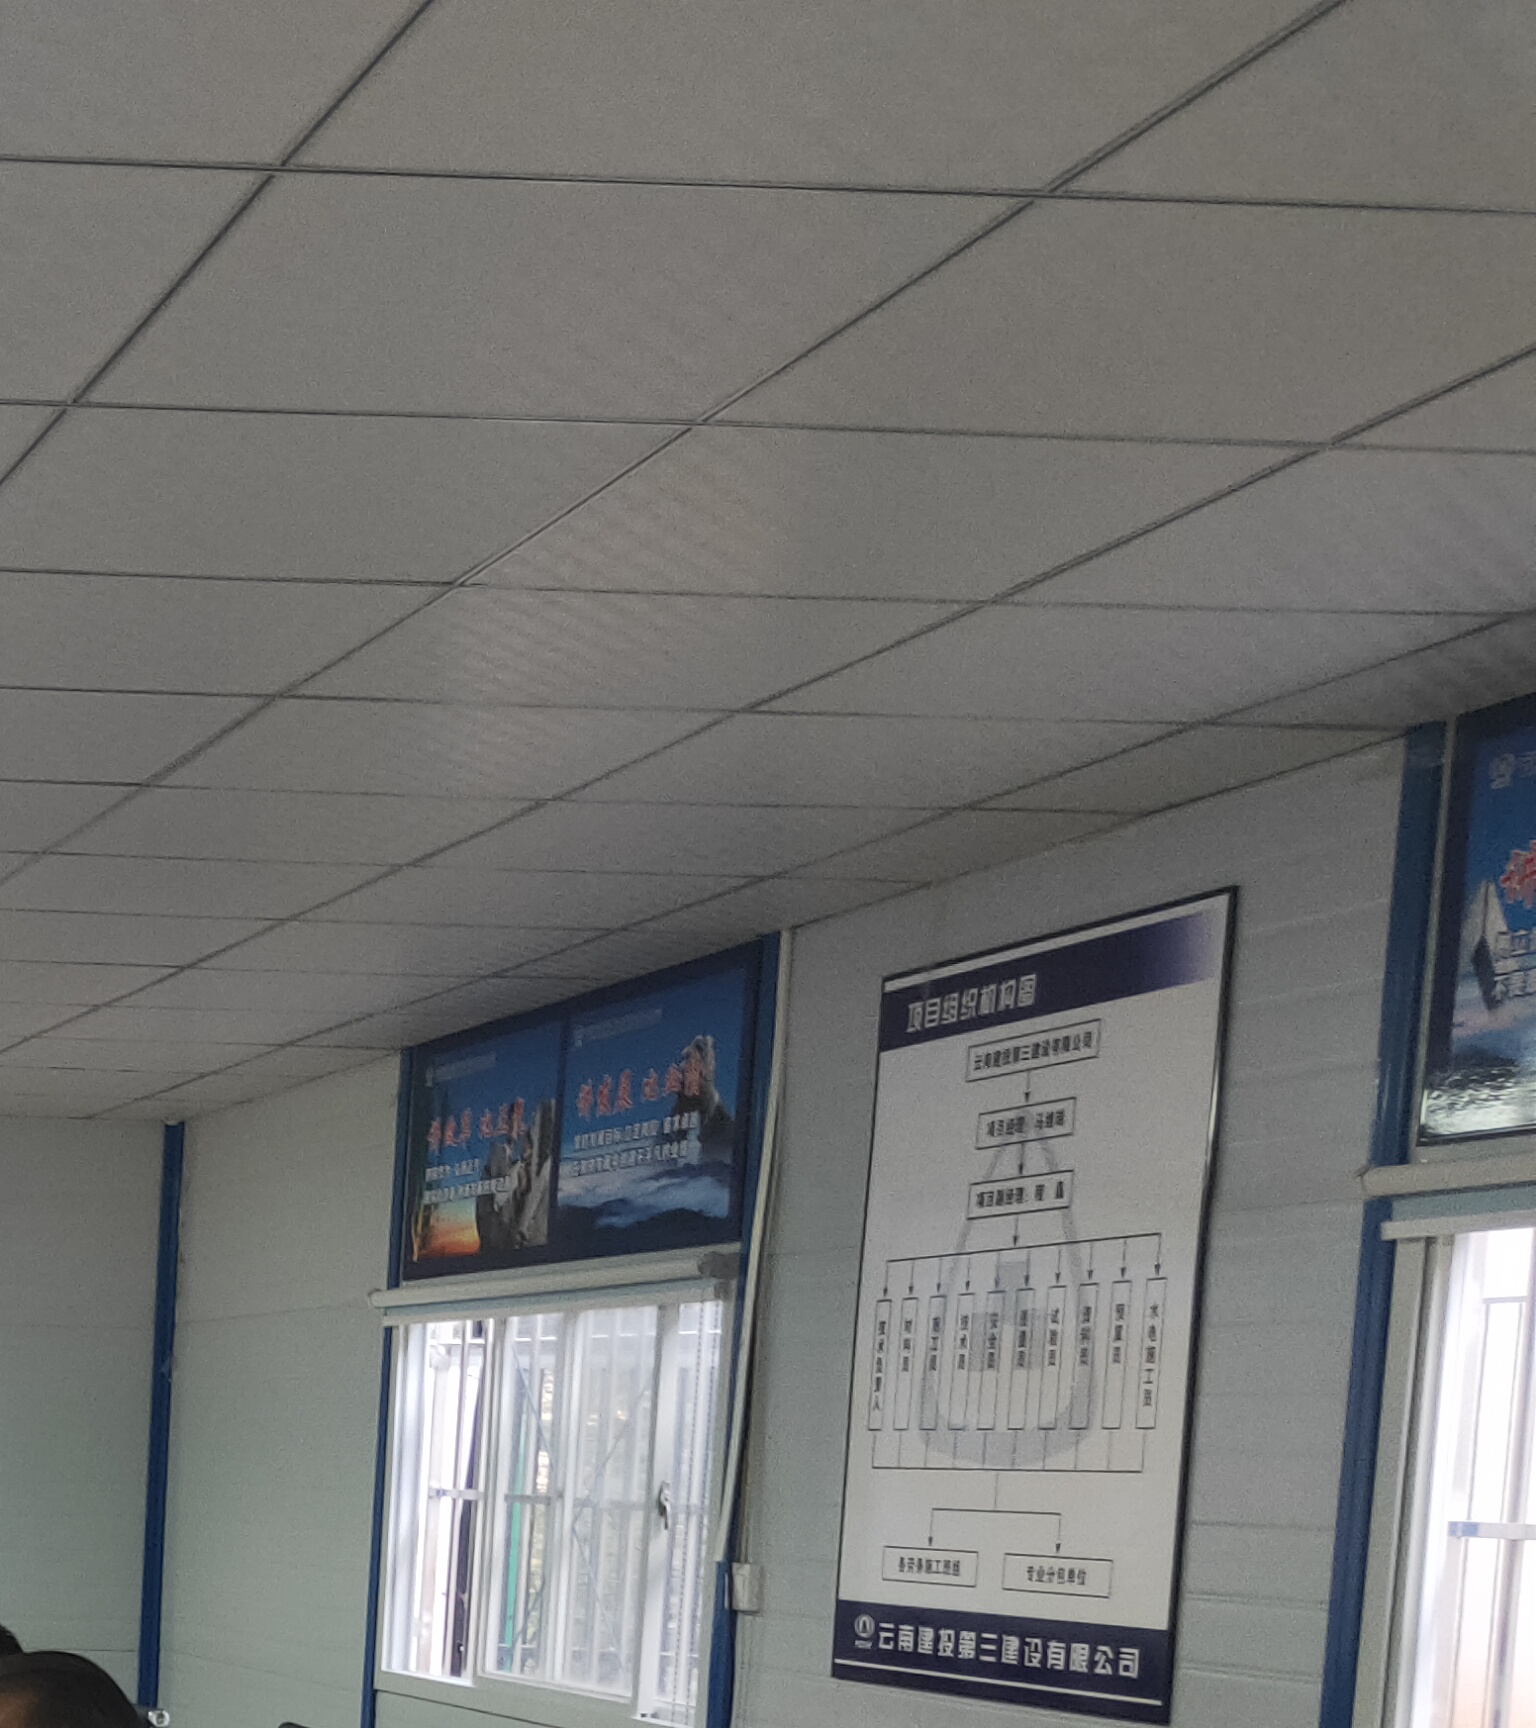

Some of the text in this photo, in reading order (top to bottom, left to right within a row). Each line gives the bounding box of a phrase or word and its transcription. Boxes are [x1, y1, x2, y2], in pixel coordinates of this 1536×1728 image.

[906, 973, 1038, 1034] 项目组织机构图
[878, 1621, 1140, 1679] 云南建投第三建设有限公司
